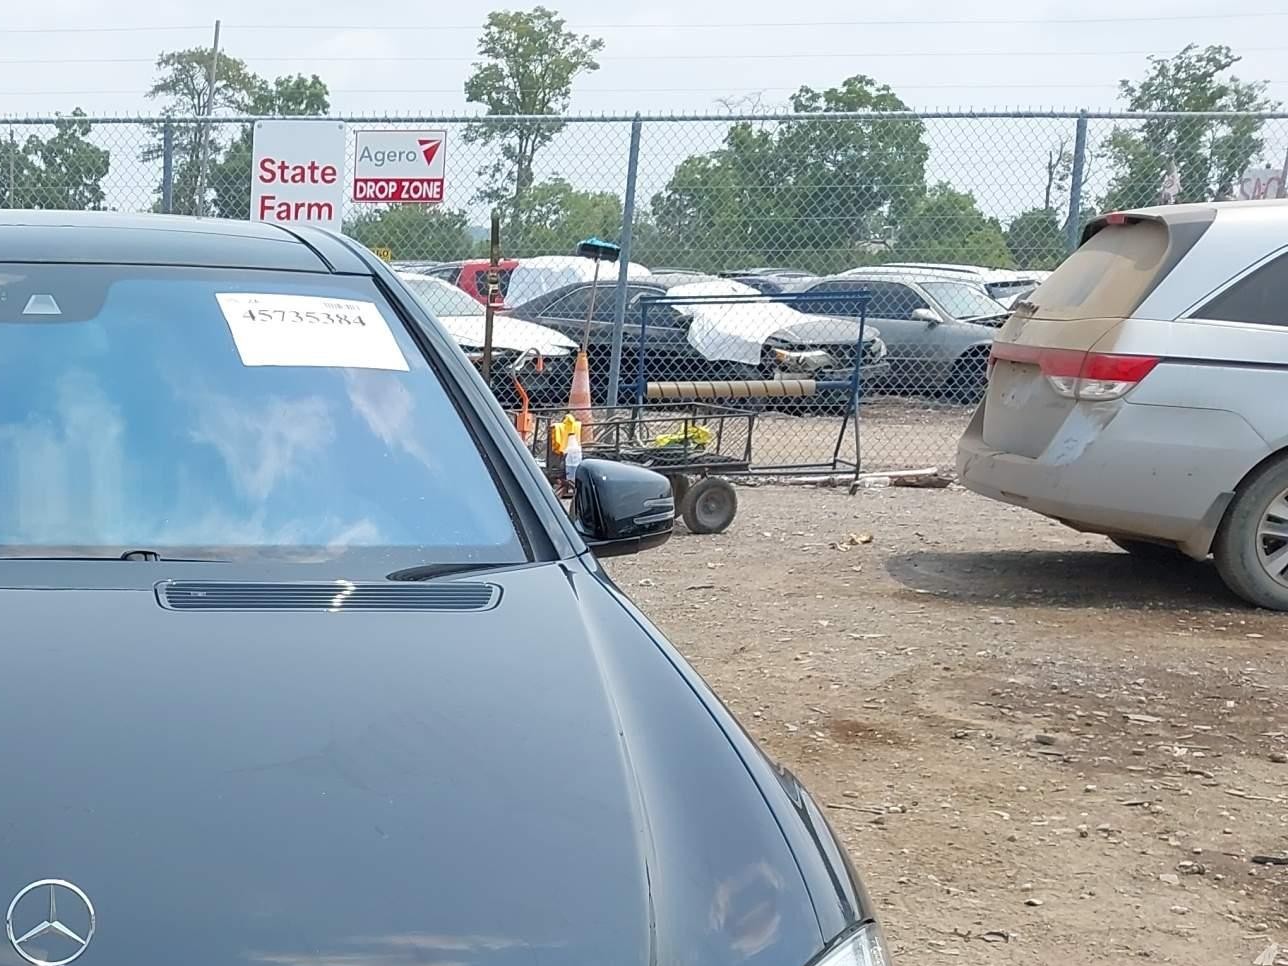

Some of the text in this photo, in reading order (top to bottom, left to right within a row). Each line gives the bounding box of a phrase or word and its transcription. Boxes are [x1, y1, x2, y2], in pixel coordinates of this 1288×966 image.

[358, 146, 417, 167] Agero
[259, 158, 337, 184] State
[355, 181, 441, 200] DROP ZONE
[259, 196, 333, 221] Farm
[243, 309, 366, 326] 45735384
